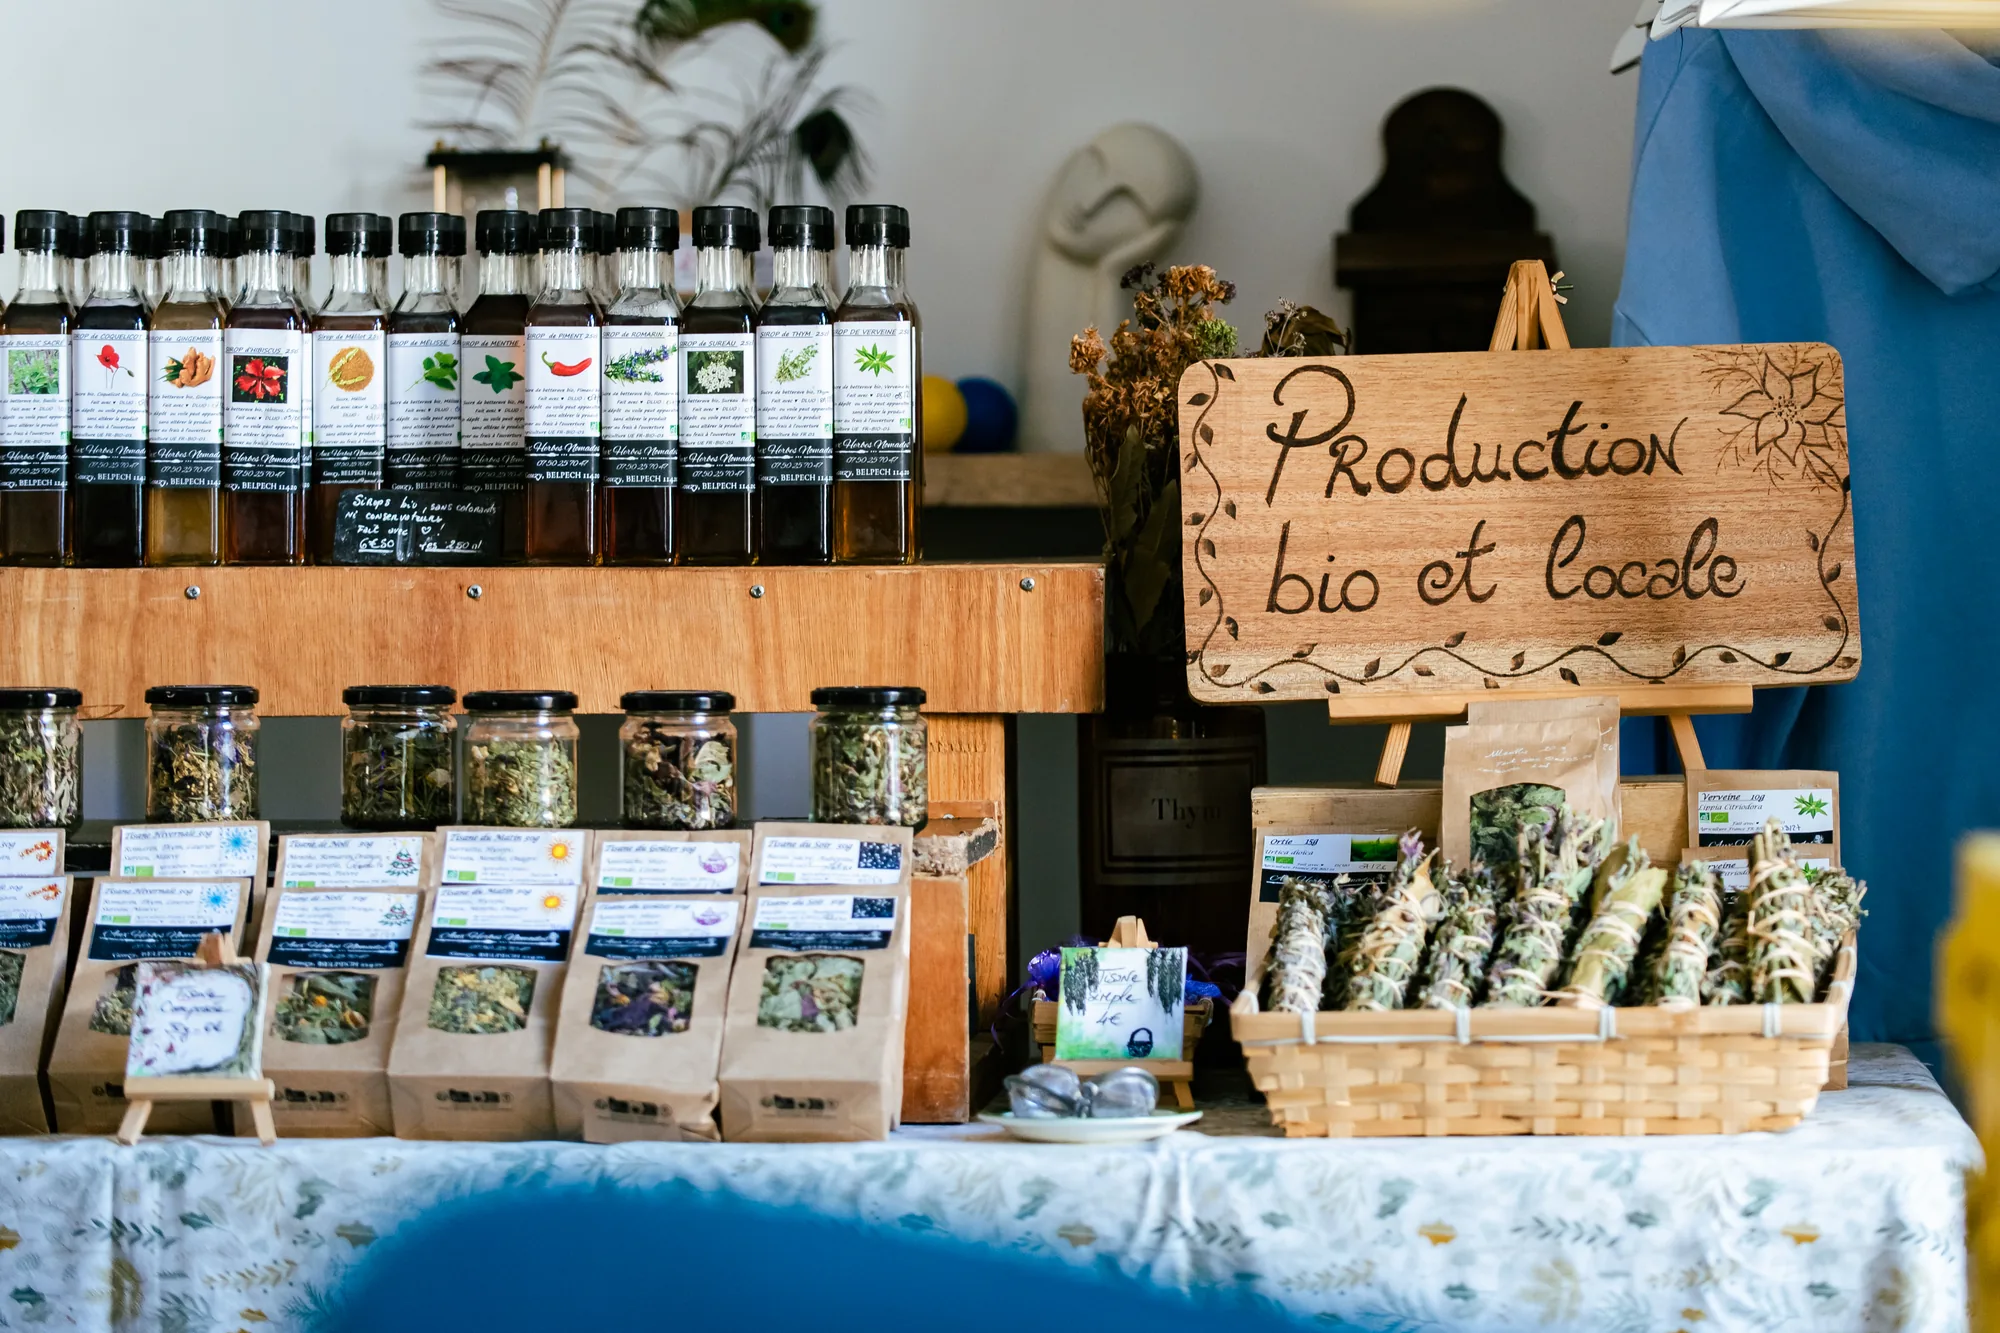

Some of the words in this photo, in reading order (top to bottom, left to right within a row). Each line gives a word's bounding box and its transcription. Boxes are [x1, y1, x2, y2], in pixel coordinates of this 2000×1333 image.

[760, 330, 780, 338] SIROP
[490, 339, 518, 347] MENTHE
[532, 441, 562, 452] Herbes
[842, 438, 872, 450] Herbes
[85, 444, 114, 454] Herbes
[115, 444, 146, 454] Nomad
[157, 448, 186, 458] Herbes
[188, 448, 220, 458] Nomad
[612, 445, 642, 456] Herbes
[643, 446, 678, 456] Nomade
[768, 444, 797, 454] Herbes
[798, 444, 833, 454] Nomade
[6, 450, 35, 461] Herbes
[36, 451, 68, 461] Nomad
[230, 452, 260, 462] Herbes
[688, 452, 718, 463] Herbes
[546, 470, 581, 480] BELPECH
[856, 468, 892, 476] BELPECH
[98, 473, 132, 481] BELPECH
[626, 474, 662, 483] BELPECH
[780, 473, 816, 482] BELPECH
[19, 479, 53, 487] BELPECH
[170, 478, 205, 486] BELPECH
[242, 482, 277, 490] BELPECH
[278, 483, 298, 491] 11420
[415, 481, 450, 490] BELPECH
[484, 482, 520, 491] BELPECH
[702, 482, 738, 490] BELPECH
[1265, 519, 1380, 614] bio
[1417, 518, 1498, 605] et
[1701, 792, 1741, 801] Verveine
[1750, 794, 1766, 802] 10g
[1151, 798, 1221, 829] Thym
[1270, 838, 1293, 846] Ortie
[1304, 838, 1320, 847] 15g
[1708, 862, 1736, 870] rveine
